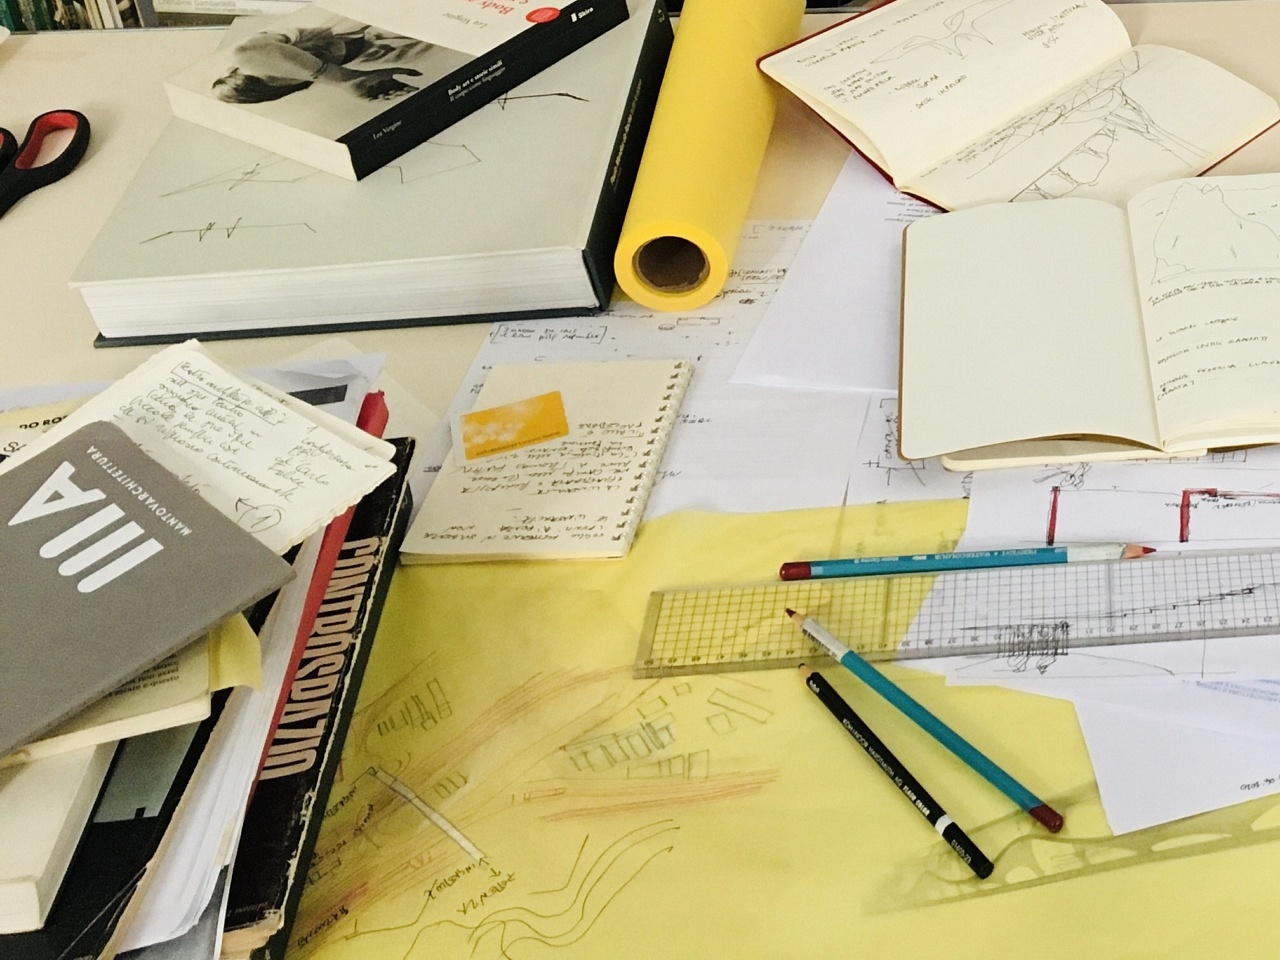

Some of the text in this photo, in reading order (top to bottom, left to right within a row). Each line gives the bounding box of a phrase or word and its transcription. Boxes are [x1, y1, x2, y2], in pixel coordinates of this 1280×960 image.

[481, 0, 516, 16] Body
[577, 5, 595, 20] Skira
[85, 444, 193, 537] MANTOVARCHITETTURA
[259, 537, 383, 782] CONTROSPAZIO
